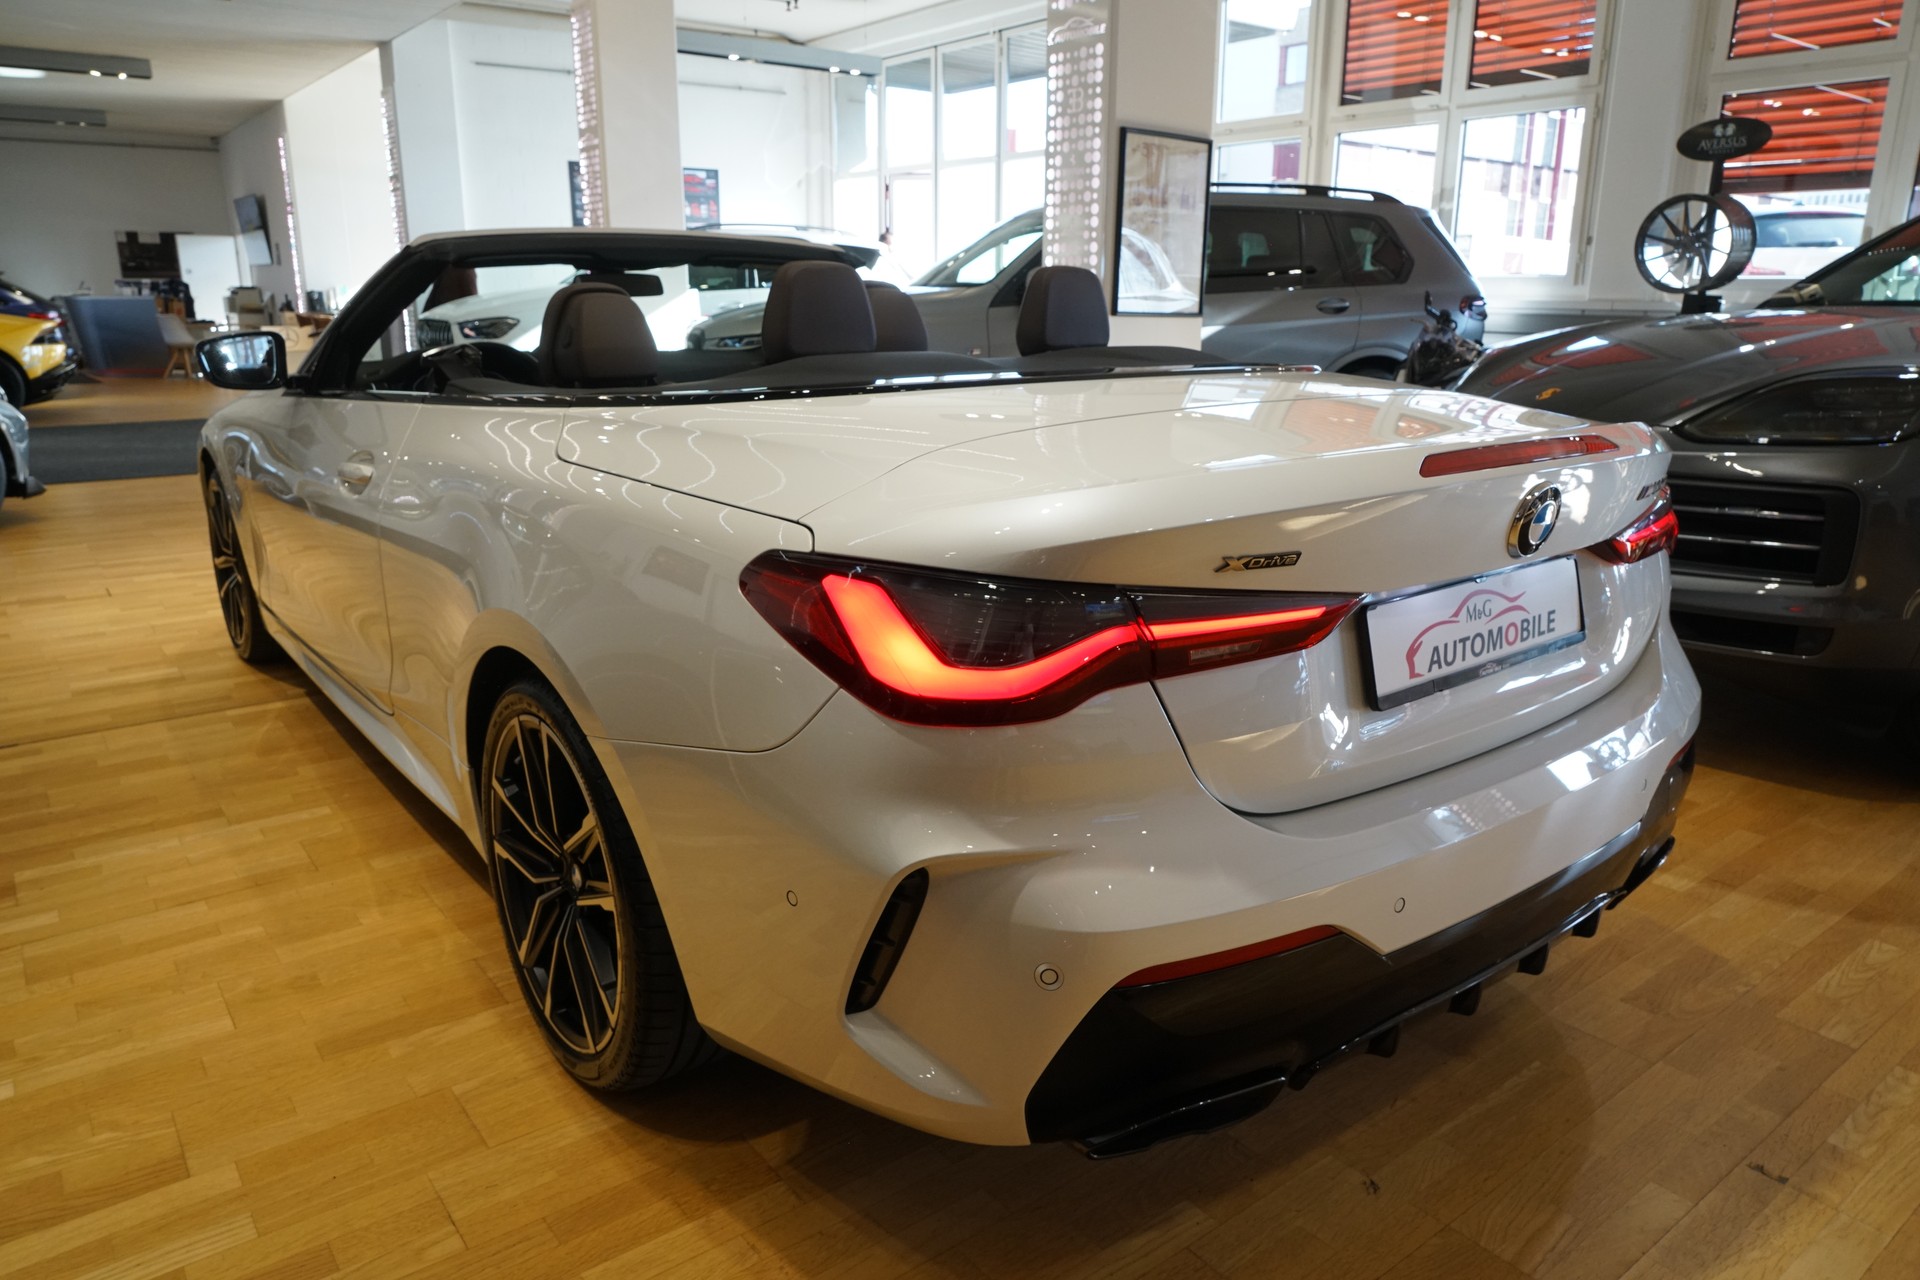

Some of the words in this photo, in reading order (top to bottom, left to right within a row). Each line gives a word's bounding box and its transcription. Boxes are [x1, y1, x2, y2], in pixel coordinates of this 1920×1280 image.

[1696, 136, 1748, 152] AVERSUS
[1465, 599, 1492, 624] M&G
[1427, 609, 1556, 673] AUTOMOBILE
